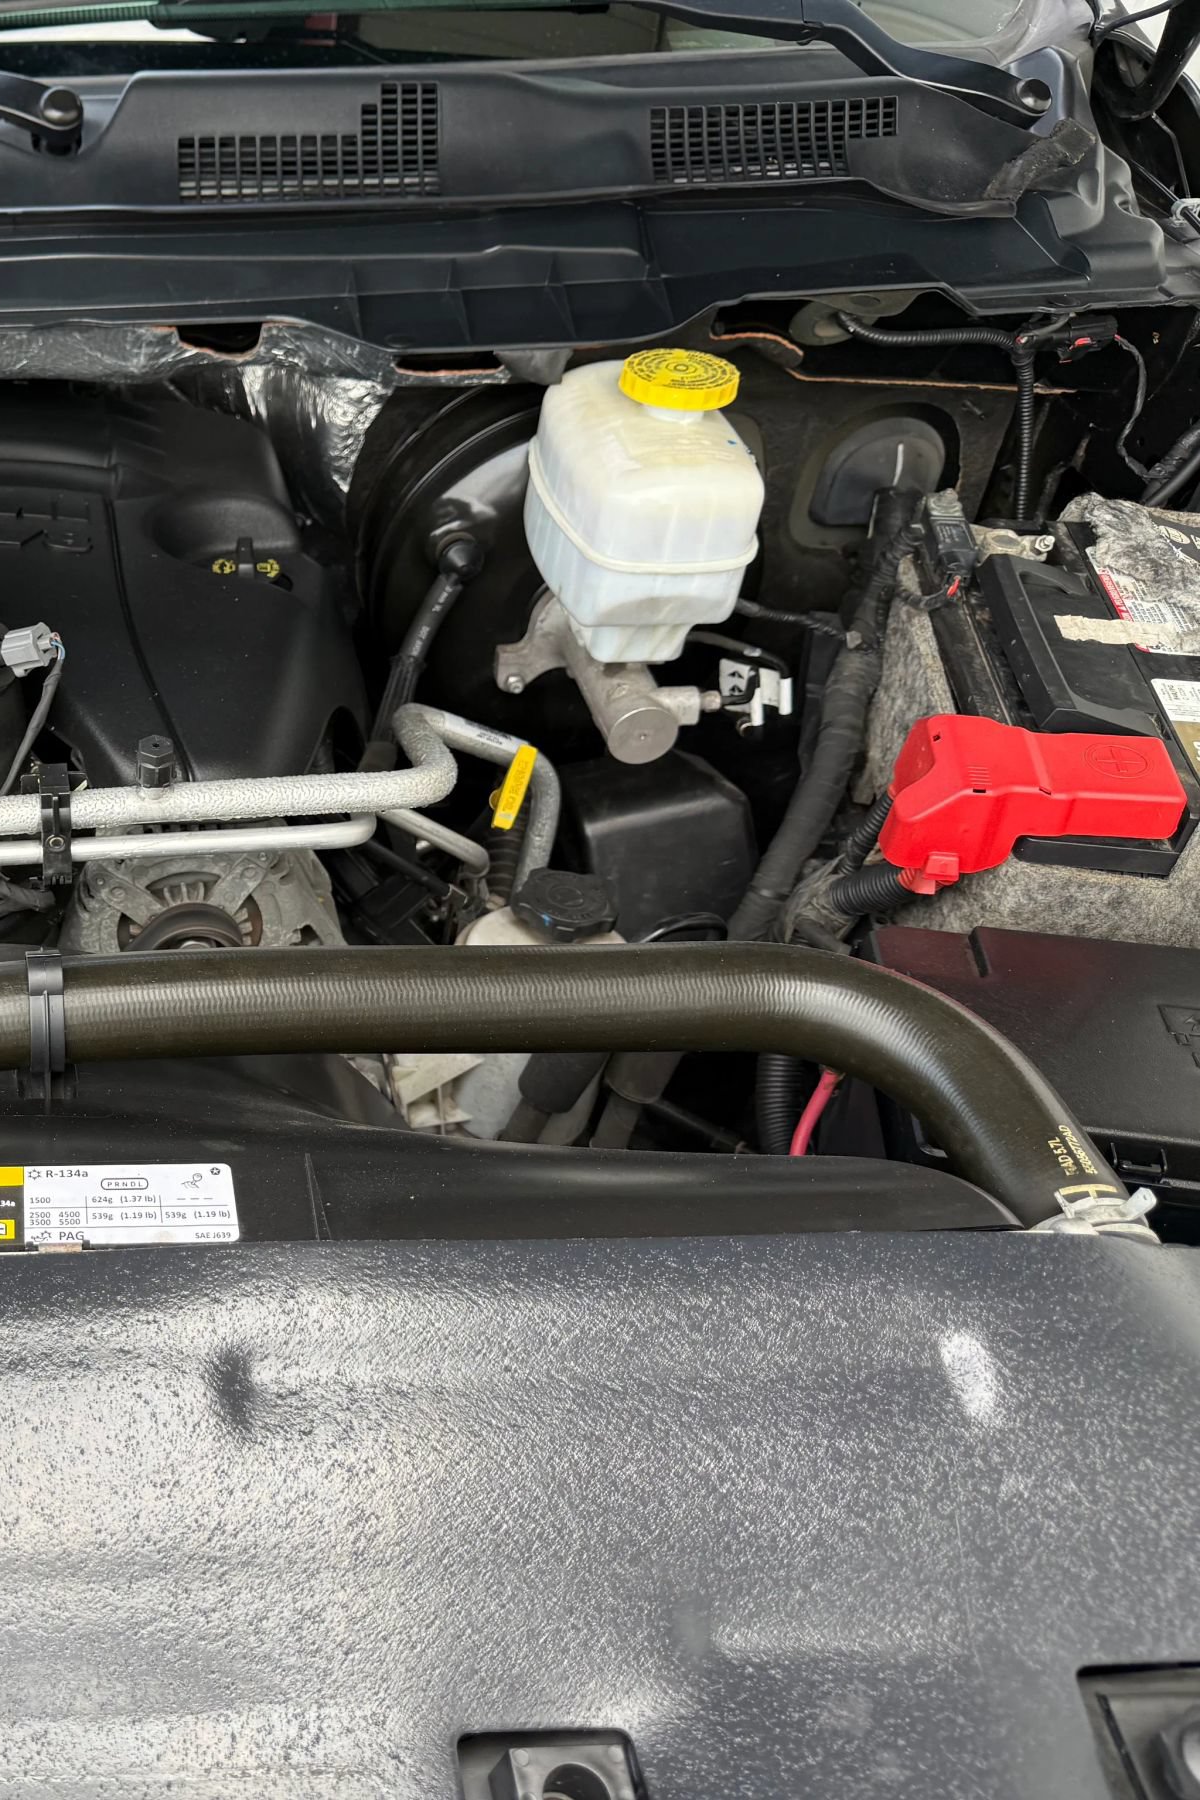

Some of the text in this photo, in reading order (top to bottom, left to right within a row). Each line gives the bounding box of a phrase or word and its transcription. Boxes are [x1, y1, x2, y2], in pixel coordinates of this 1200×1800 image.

[46, 1169, 88, 1178] R-134a
[29, 1196, 51, 1204] 1500
[92, 1194, 156, 1204] 624g (1.37 lb)
[29, 1211, 51, 1219] 2500
[92, 1211, 157, 1221] 539g (1.19 lb)
[165, 1210, 231, 1220] 539g (1.19 lb)
[29, 1218, 51, 1226] 3500
[59, 1231, 85, 1241] PAG
[213, 1231, 231, 1239] J639
